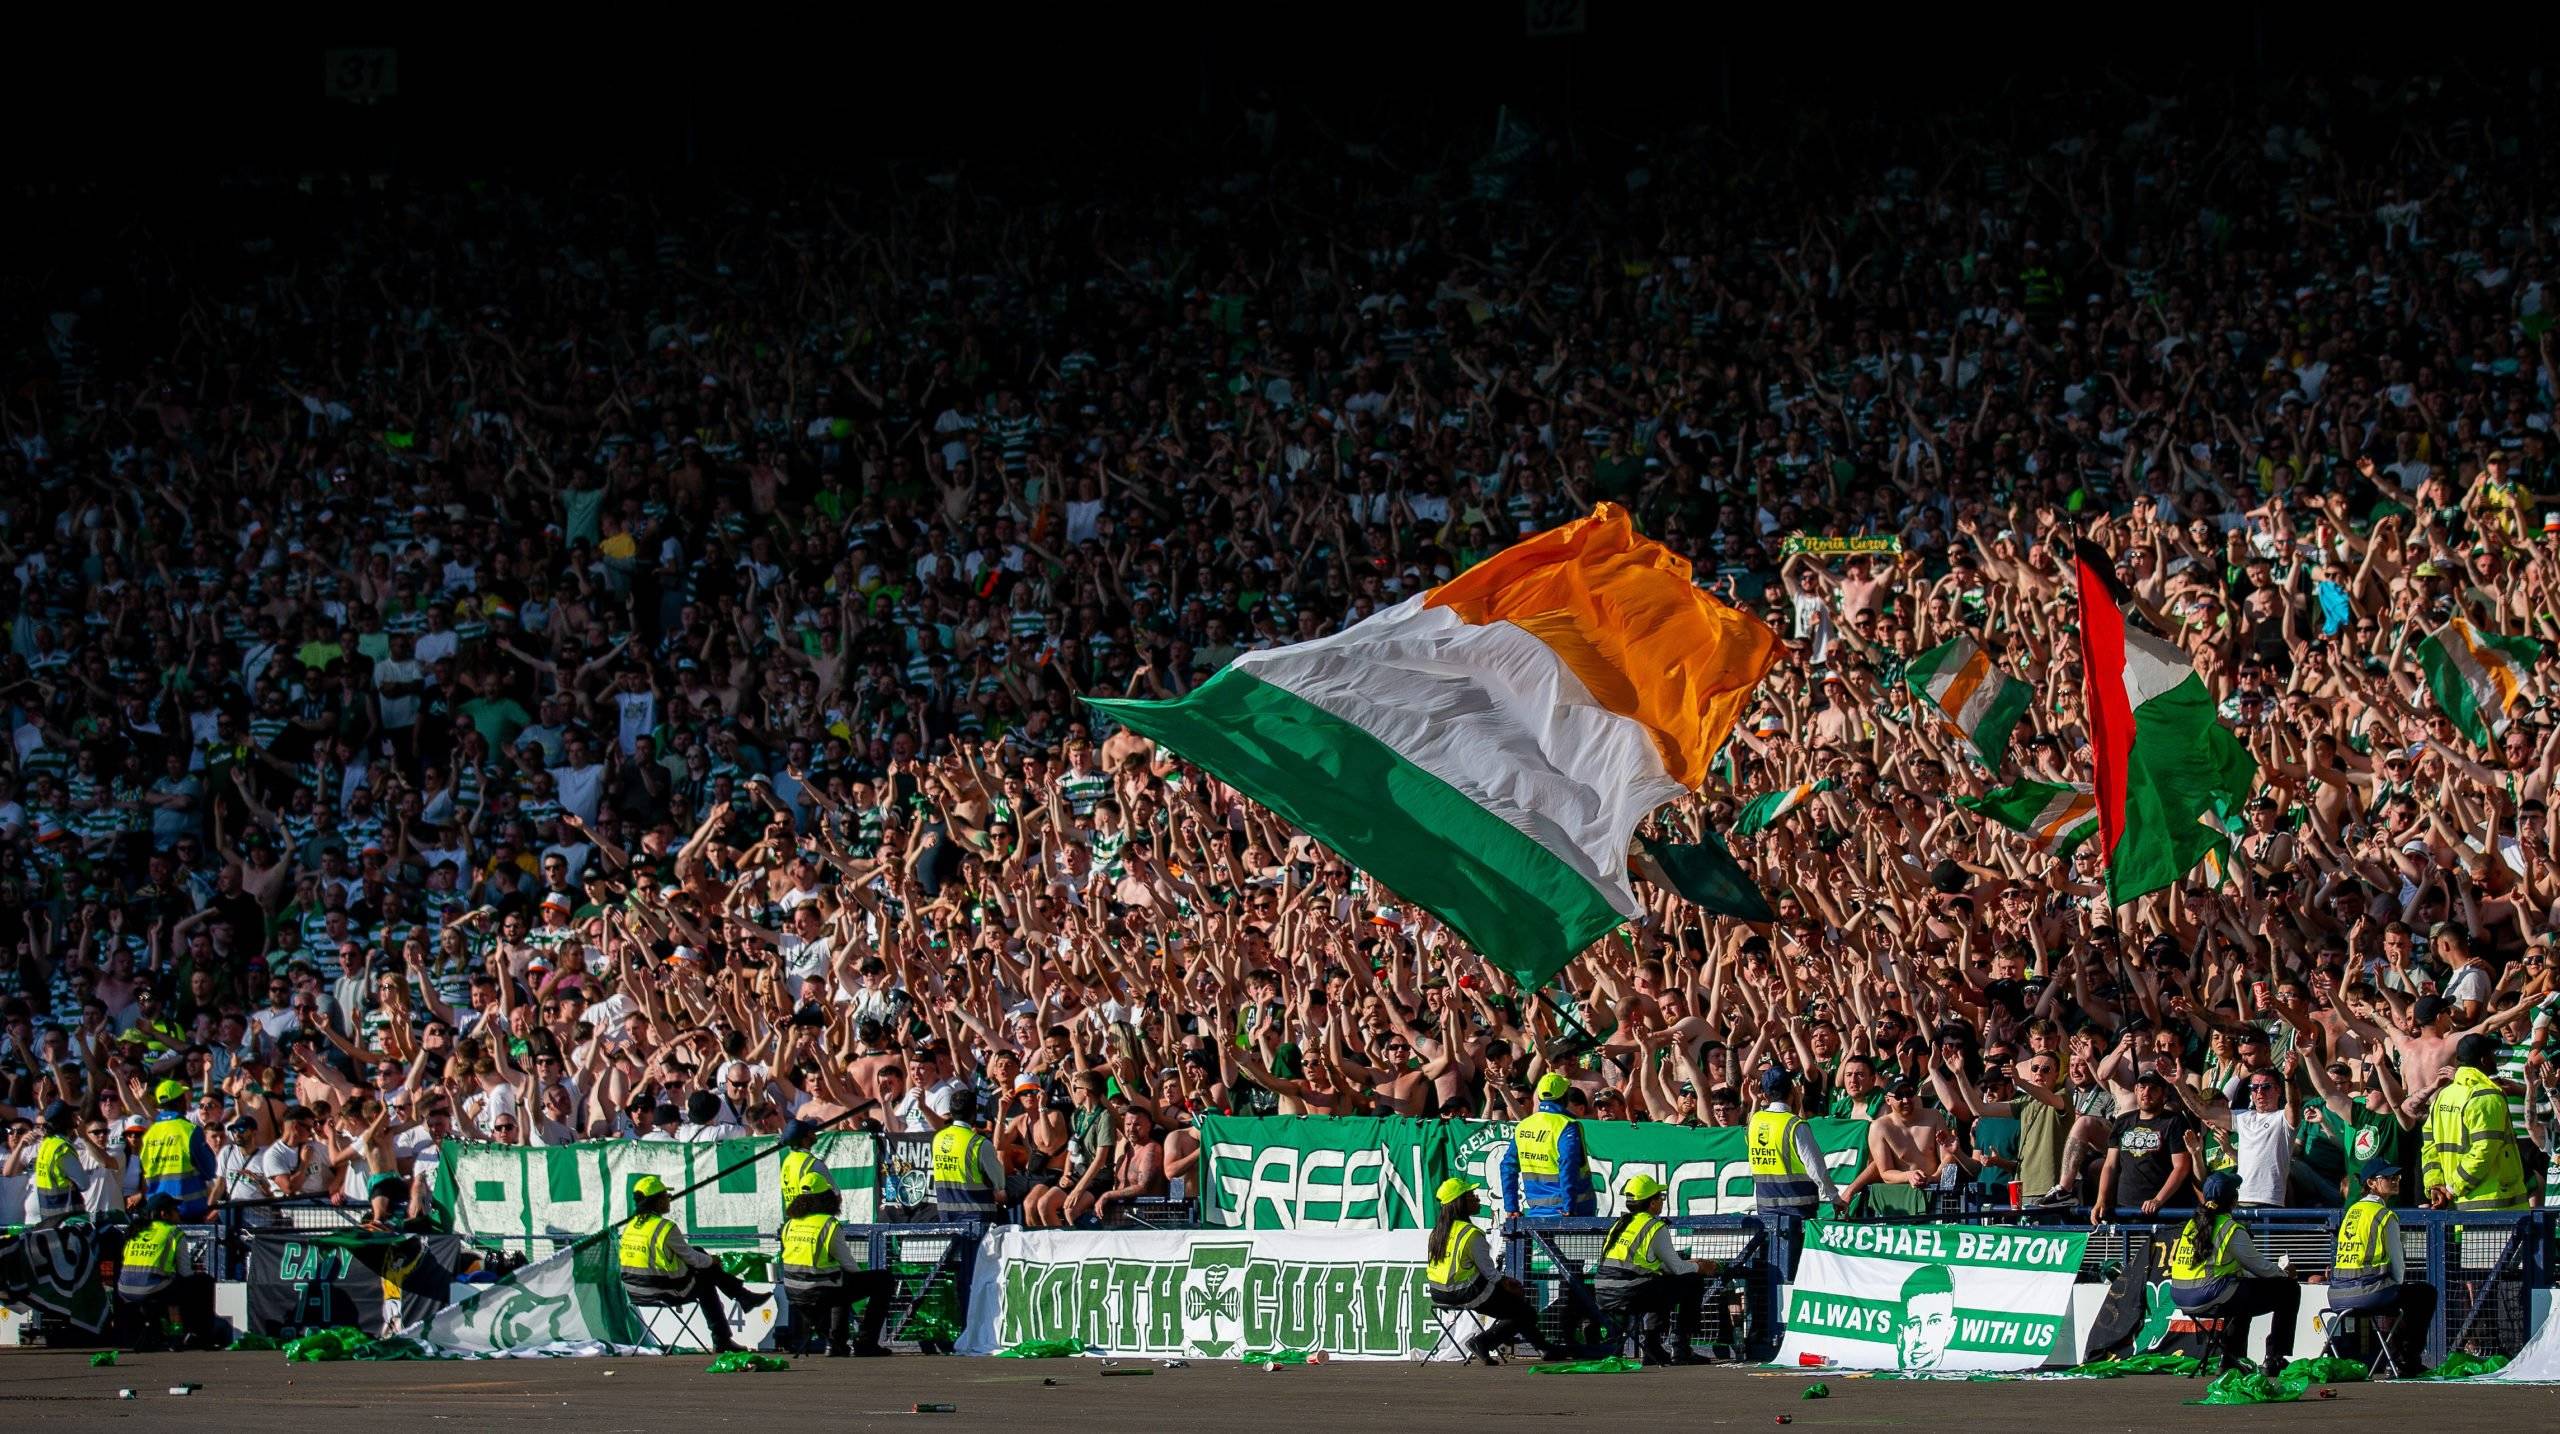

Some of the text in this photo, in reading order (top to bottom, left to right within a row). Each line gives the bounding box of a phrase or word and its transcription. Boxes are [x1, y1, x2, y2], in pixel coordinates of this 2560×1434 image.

[336, 55, 384, 91] 31
[1803, 537, 1845, 551] North
[1520, 1130, 1536, 1138] SGL
[1455, 1124, 1497, 1171] GREEN
[1752, 1148, 1776, 1157] EVENT
[935, 1155, 959, 1163] EVENT
[1520, 1152, 1549, 1161] TEWARD
[1752, 1157, 1777, 1166] STAFF
[936, 1163, 958, 1171] STAFF
[1206, 1142, 1424, 1229] GREEN
[1820, 1225, 2069, 1265] MICHAEL BEATON
[1001, 1257, 1442, 1354] NORTH CURVE
[1797, 1300, 2055, 1347] ALWAYS WITH US
